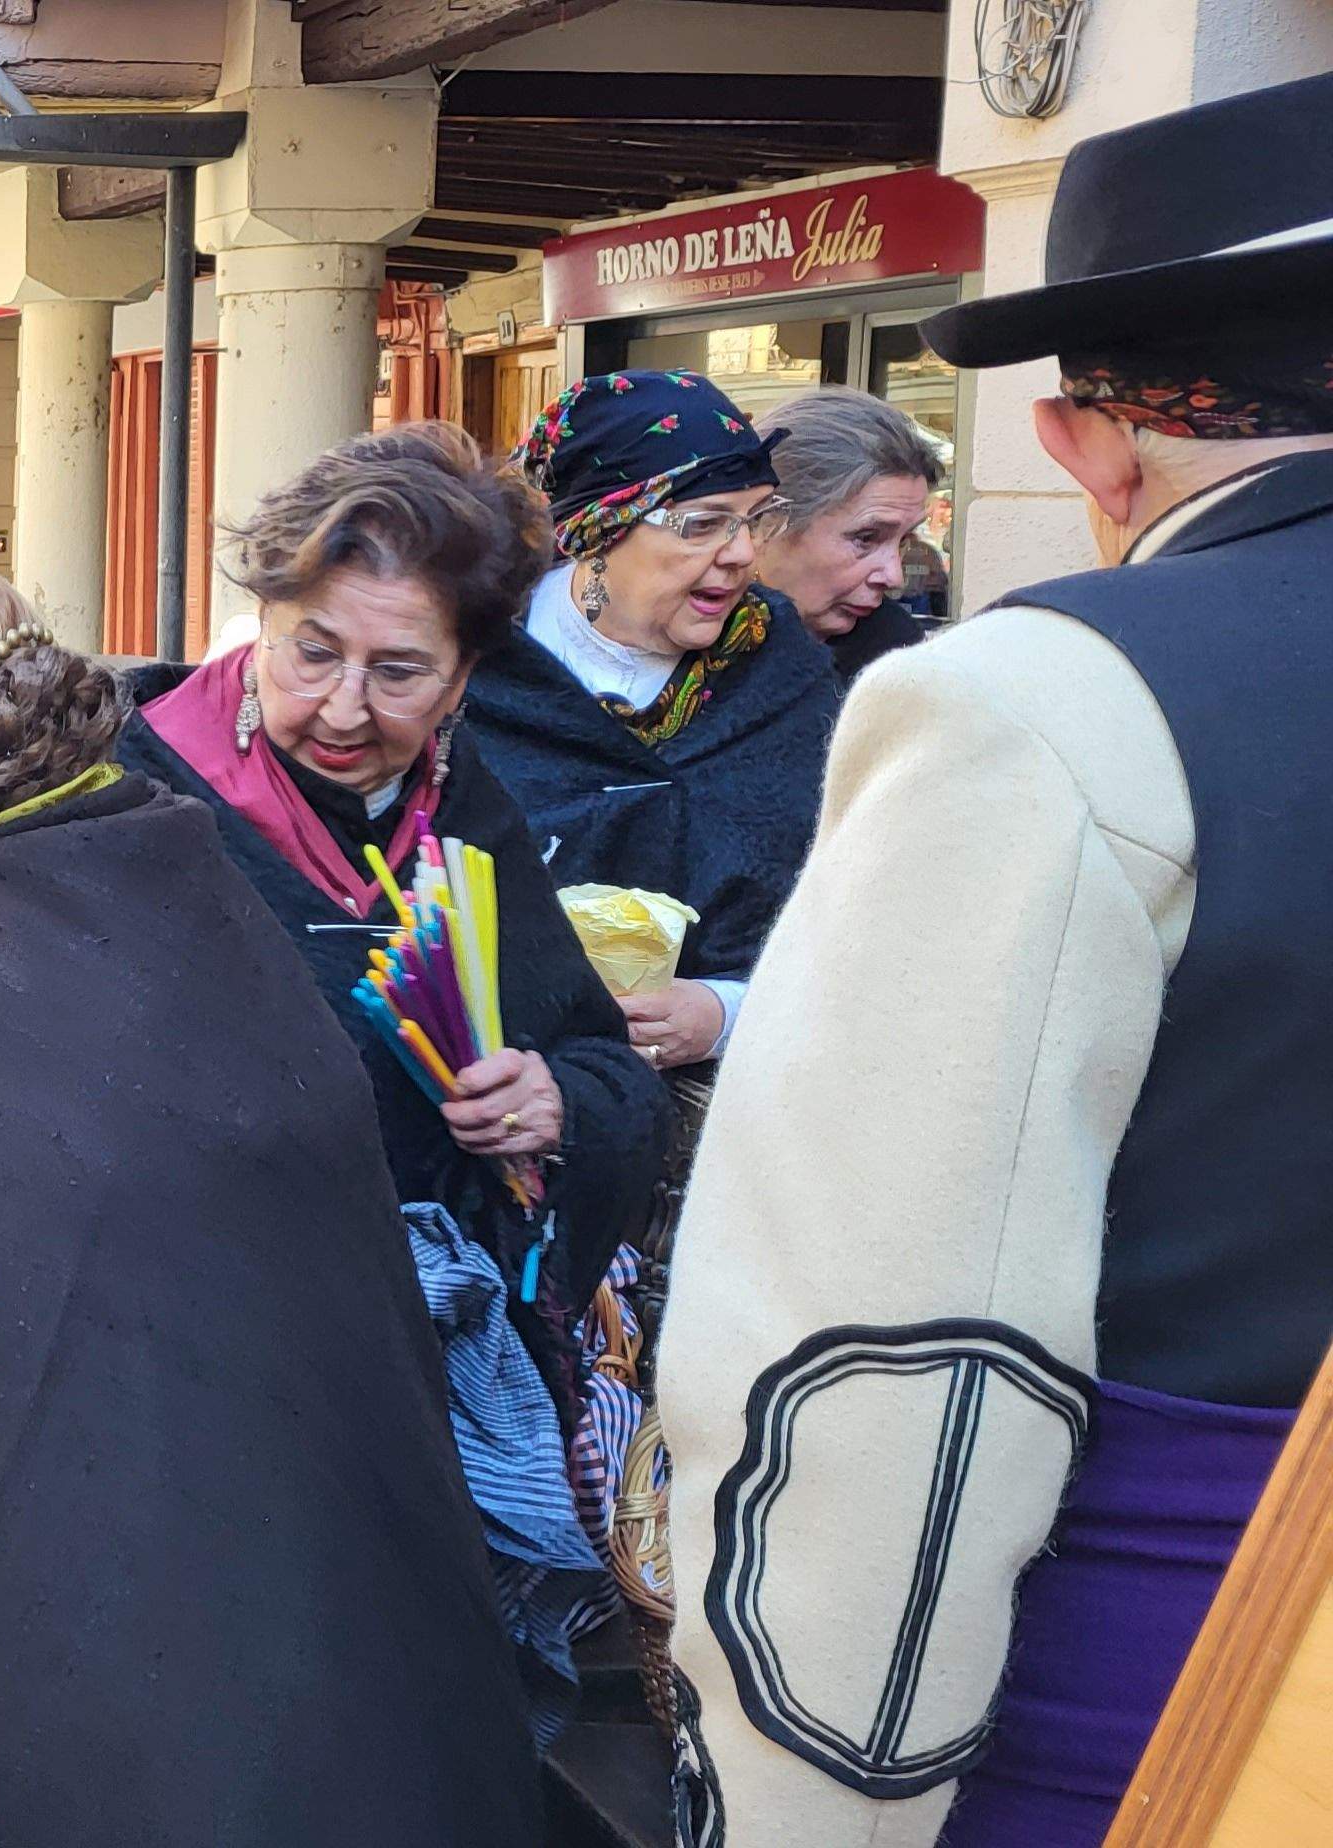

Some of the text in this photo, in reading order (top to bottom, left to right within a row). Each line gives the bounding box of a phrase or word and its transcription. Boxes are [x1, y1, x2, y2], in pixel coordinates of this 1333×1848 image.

[596, 194, 884, 286] HORNO DE LEÑA Julia
